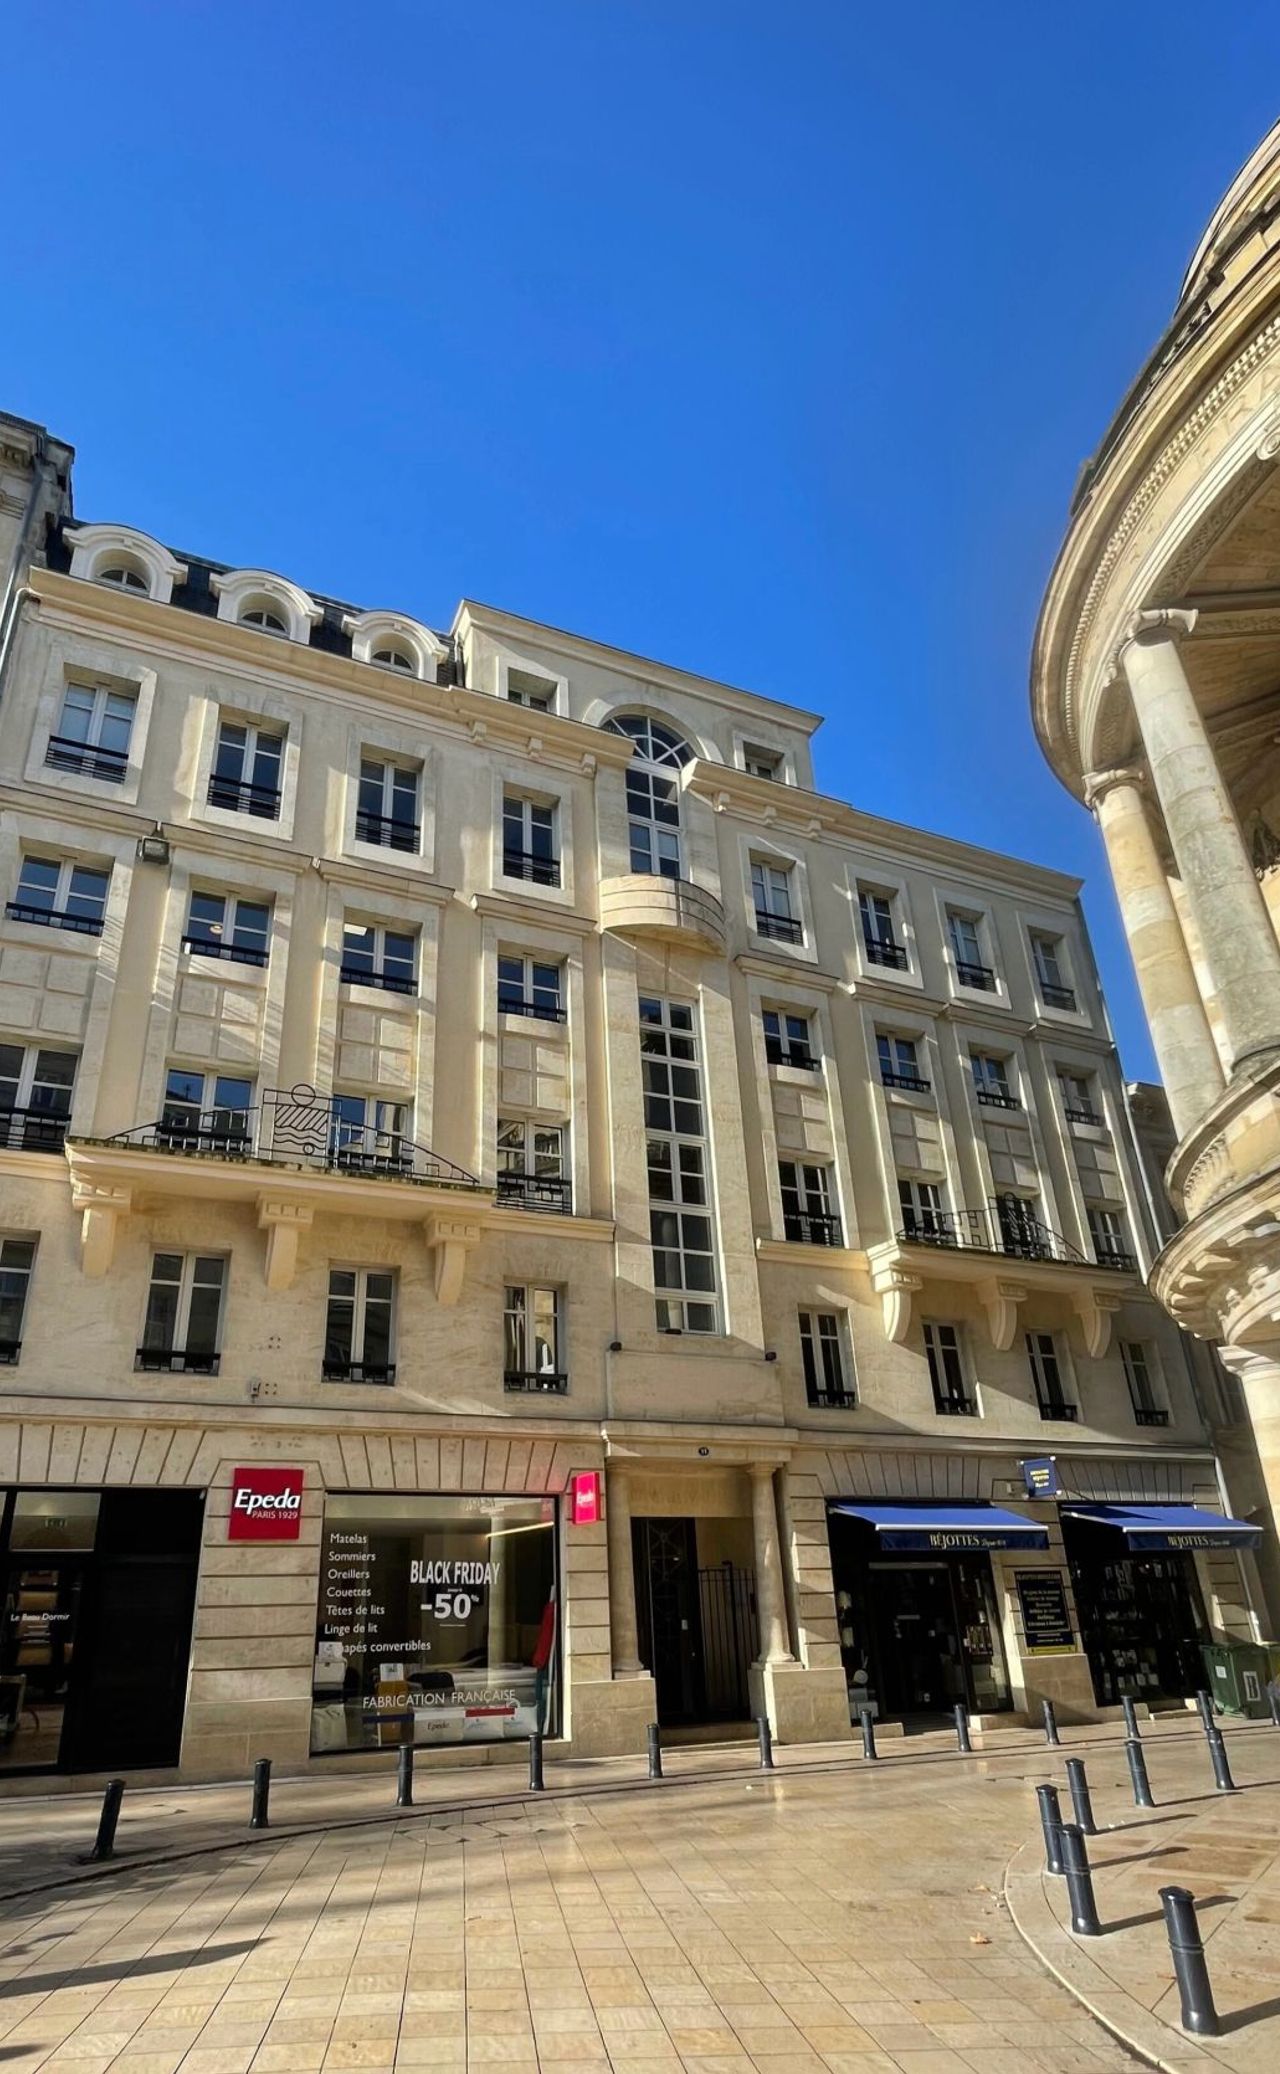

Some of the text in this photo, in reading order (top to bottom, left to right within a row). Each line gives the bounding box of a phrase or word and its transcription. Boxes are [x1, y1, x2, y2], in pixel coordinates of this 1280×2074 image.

[234, 1488, 301, 1515] Epeda
[252, 1510, 298, 1519] PARIS 1929
[330, 1533, 367, 1544] Matelas
[328, 1551, 376, 1561] Sommiers
[328, 1568, 370, 1579] Oreillers
[410, 1560, 501, 1585] BLACK FRIDAY
[326, 1587, 372, 1597] Couettes
[326, 1604, 385, 1616] Têtes de lits
[42, 1612, 70, 1620] Dormir
[324, 1622, 378, 1636] Linge de lit
[370, 1640, 431, 1652] convertibles
[362, 1689, 516, 1709] FABRICATION FRANÇAISE
